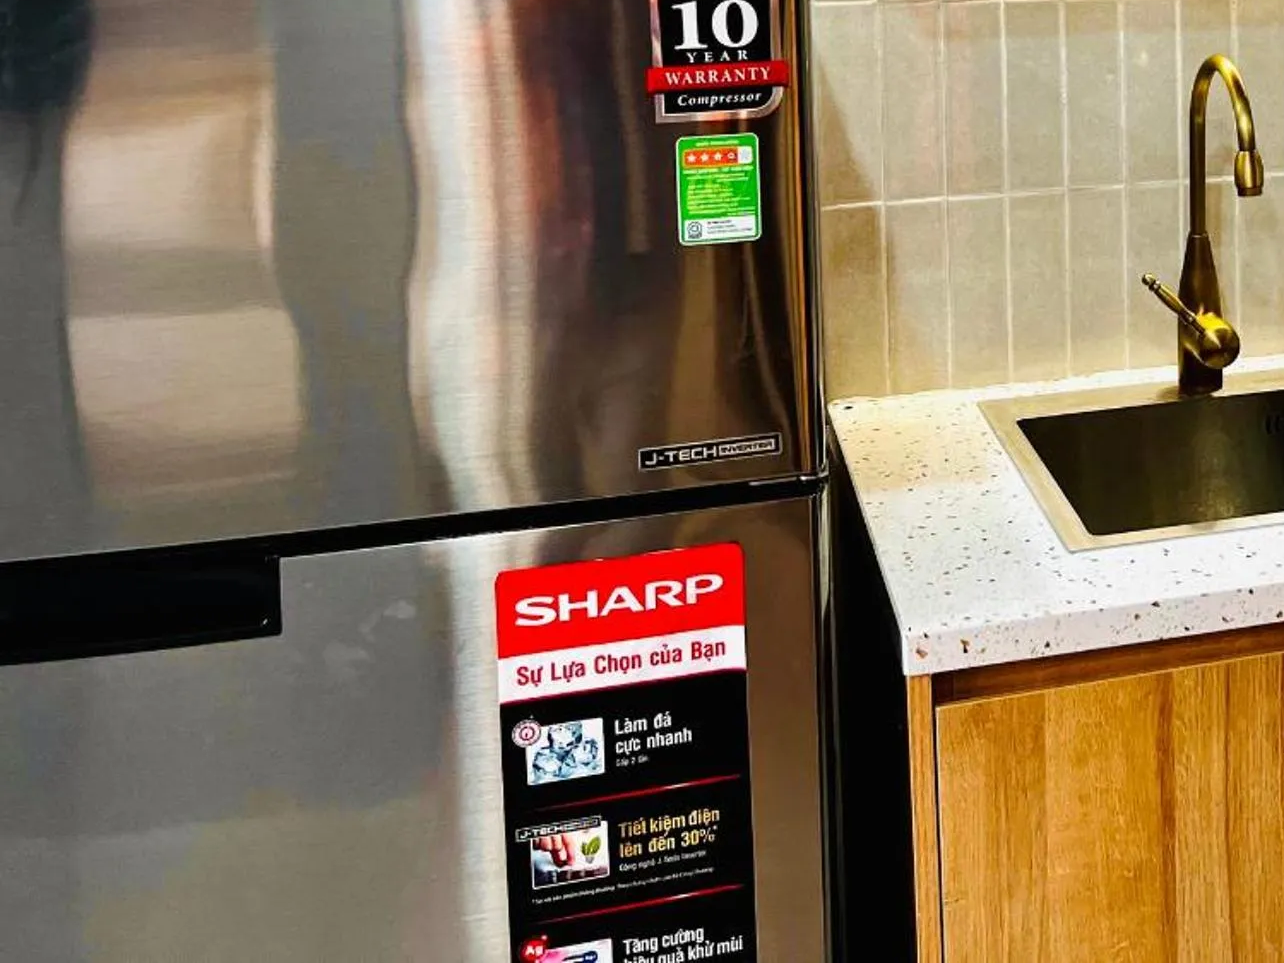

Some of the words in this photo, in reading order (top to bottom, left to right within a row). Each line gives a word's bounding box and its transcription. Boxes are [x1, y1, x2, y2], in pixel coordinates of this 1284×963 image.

[686, 49, 749, 63] YEAR
[664, 66, 771, 86] WARRANTY
[677, 92, 763, 108] Compressor
[644, 445, 718, 465] J-TECH
[514, 573, 724, 627] SHARP
[516, 665, 544, 688] Sự
[550, 660, 586, 684] Lựa
[593, 653, 643, 675] Chọn
[650, 643, 683, 667] của
[691, 640, 727, 663] Bạn
[614, 716, 648, 736] Làm
[653, 711, 672, 729] đá
[615, 738, 641, 757] cực
[646, 728, 693, 749] nhanh
[618, 816, 647, 838] Tiết
[650, 813, 686, 835] kiệm
[688, 808, 720, 831] điện
[619, 838, 643, 859] lên
[648, 833, 676, 853] đến
[622, 936, 658, 957] Tăng
[662, 927, 705, 948] cường
[687, 939, 715, 960] khử
[716, 934, 744, 955] mùi
